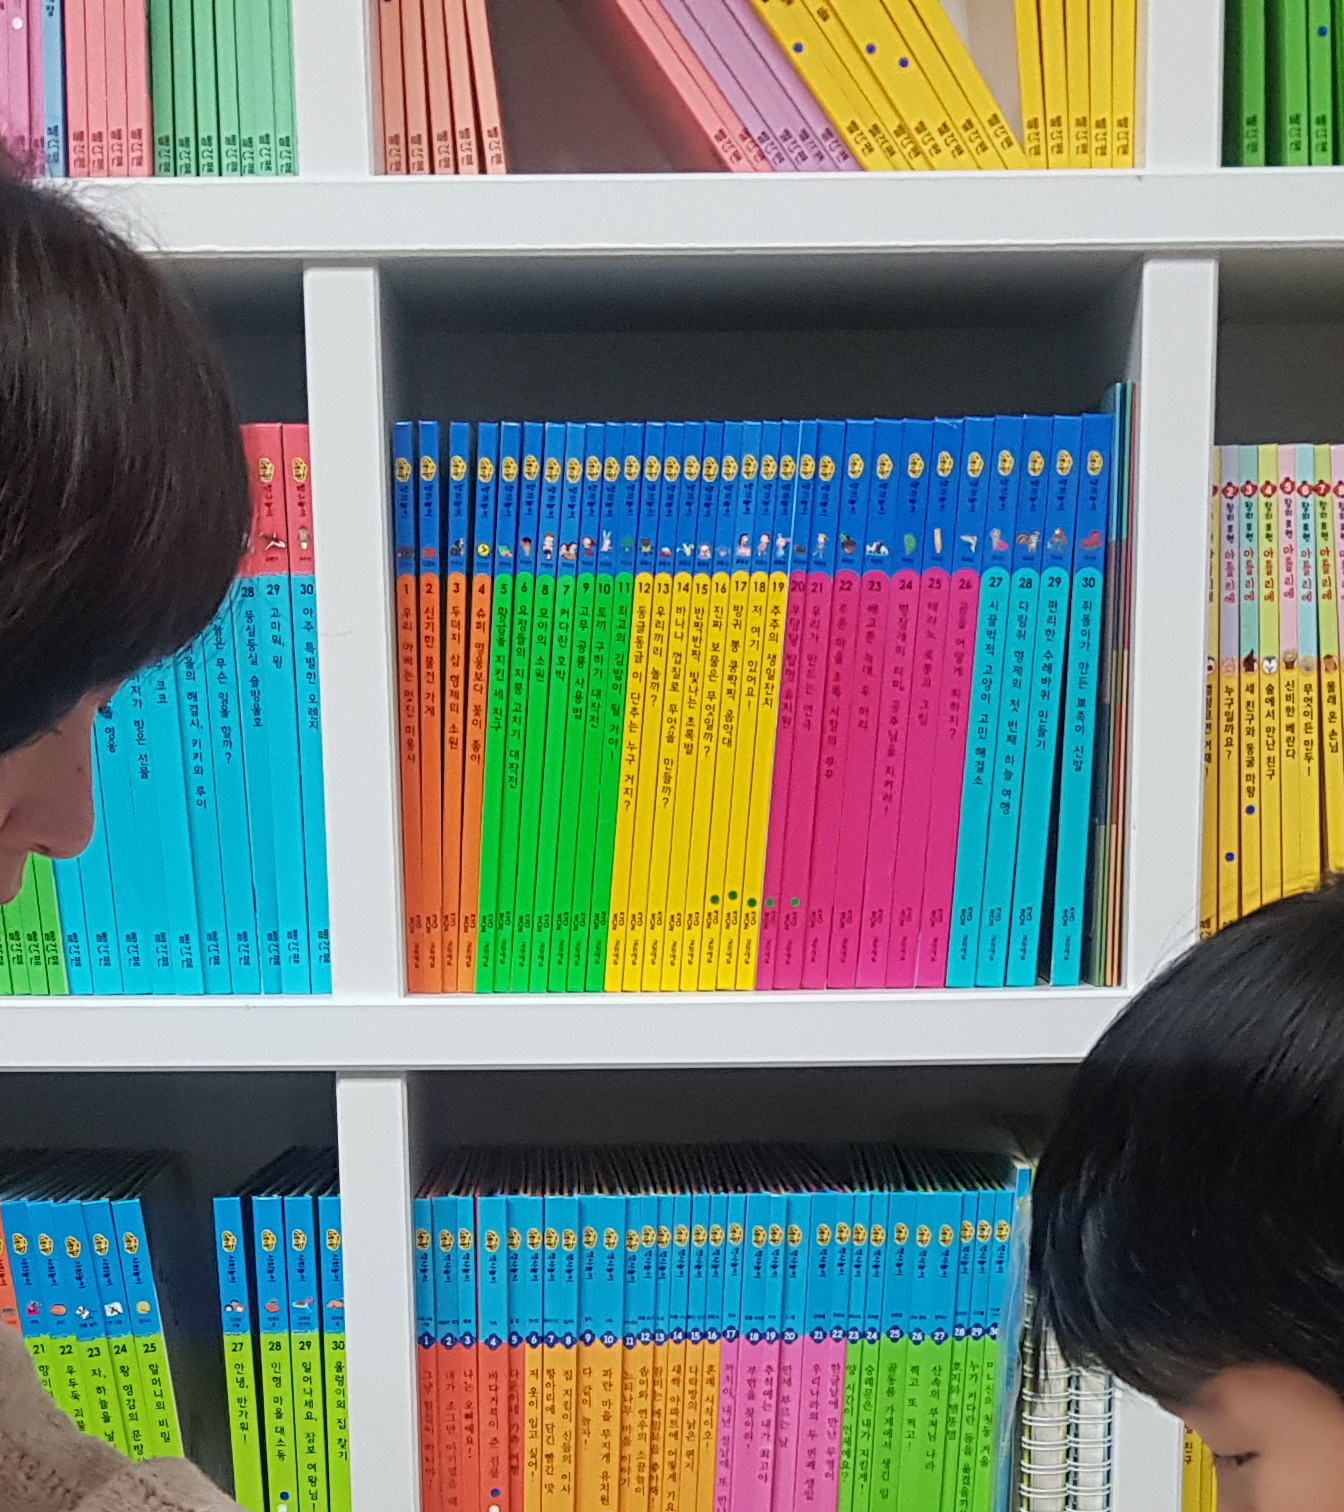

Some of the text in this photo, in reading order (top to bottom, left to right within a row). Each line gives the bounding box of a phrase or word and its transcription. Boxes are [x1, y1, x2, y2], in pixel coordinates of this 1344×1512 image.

[521, 582, 528, 593] 6
[583, 582, 590, 593] 9
[677, 581, 690, 593] 14
[754, 581, 766, 592] 18
[772, 582, 785, 593] 19
[840, 580, 853, 591] 22
[868, 580, 881, 591] 23
[899, 580, 913, 590] 24
[928, 578, 942, 589] 25
[989, 577, 1003, 587] 27
[1048, 577, 1061, 588] 29
[267, 584, 280, 595] 29
[300, 584, 313, 595] 30
[426, 583, 433, 594] 2
[453, 583, 460, 594] 3
[542, 584, 549, 595] 8
[563, 584, 570, 595] 7
[598, 583, 611, 594] 10
[638, 583, 650, 594] 12
[657, 583, 670, 594] 13
[695, 583, 708, 594] 15
[715, 582, 727, 594] 16
[303, 608, 314, 632] 아주
[424, 606, 435, 648] 신기한
[216, 659, 227, 684] 무슨
[424, 1335, 429, 1345] 1
[641, 1332, 650, 1341] 12
[655, 1333, 664, 1342] 13
[673, 1332, 682, 1340] 14
[691, 1332, 700, 1341] 15
[707, 1332, 717, 1340] 16
[726, 1330, 735, 1339] 17
[749, 1333, 759, 1341] 18
[766, 1332, 776, 1341] 19
[784, 1332, 795, 1340] 20
[231, 1342, 244, 1352] 27
[269, 1341, 282, 1351] 28
[332, 1342, 345, 1351] 30
[446, 1337, 452, 1346] 2
[626, 1337, 633, 1346] 11
[33, 1343, 45, 1354] 21
[88, 1347, 100, 1358] 23
[143, 1343, 156, 1353] 25
